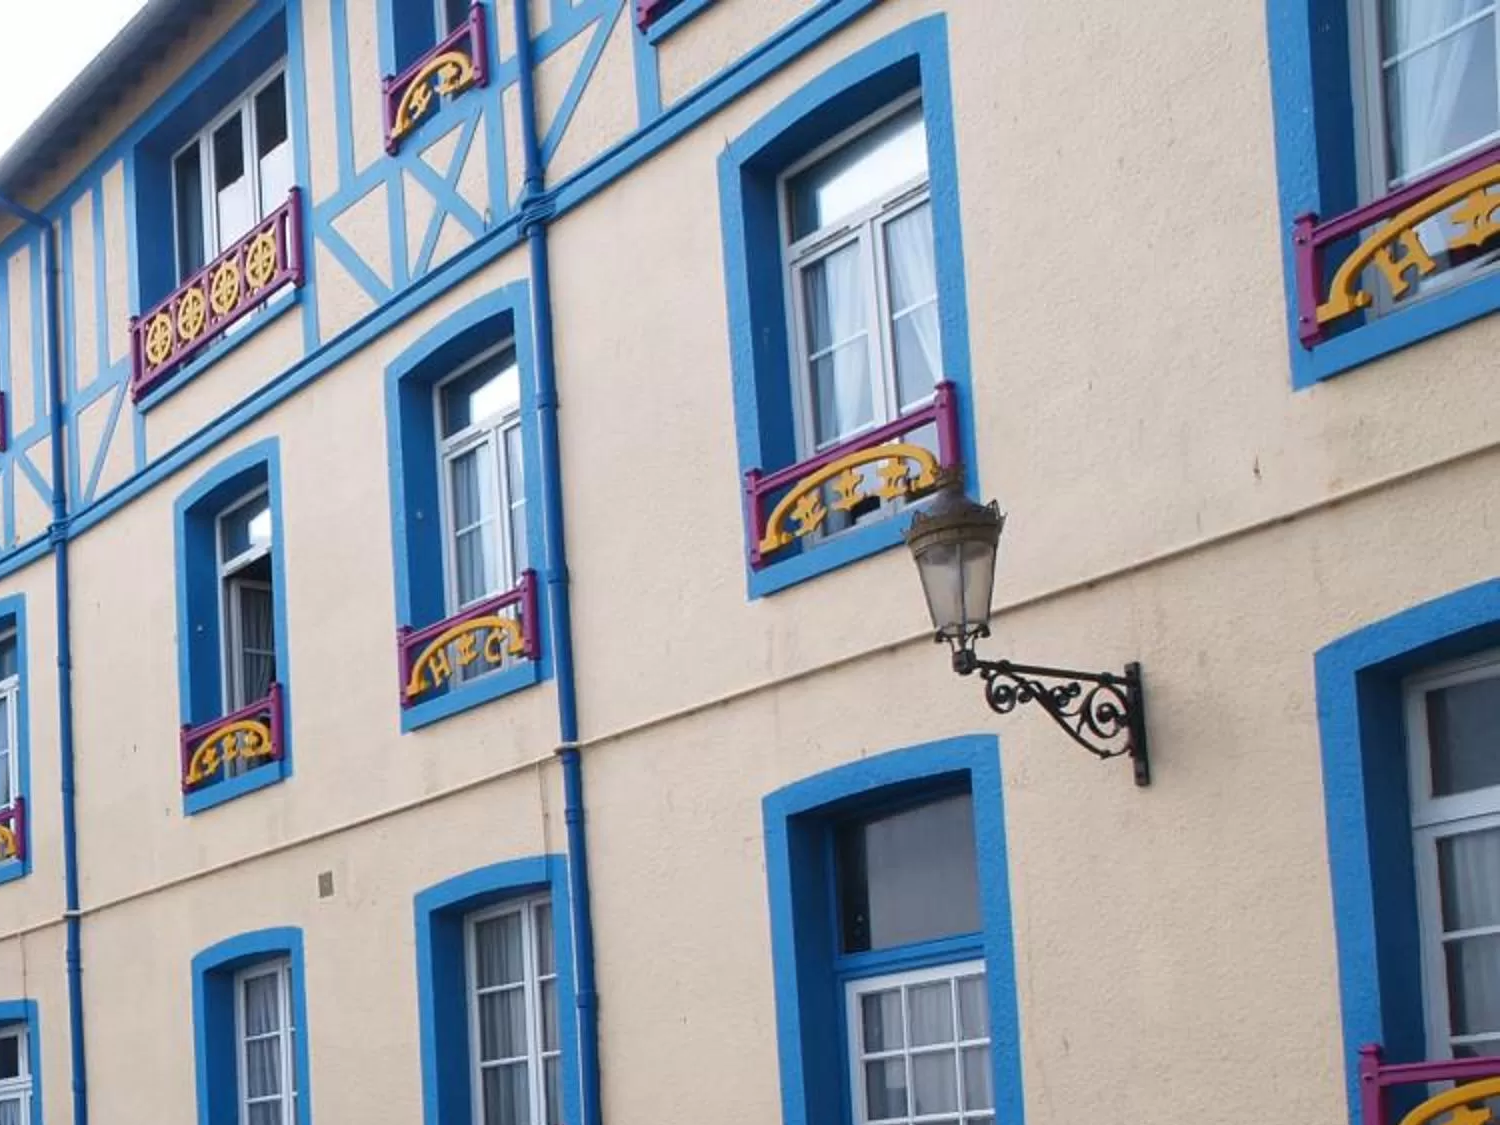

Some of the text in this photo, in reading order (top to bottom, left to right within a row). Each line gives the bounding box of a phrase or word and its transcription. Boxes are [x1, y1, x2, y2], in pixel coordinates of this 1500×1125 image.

[1374, 228, 1436, 301] H
[428, 631, 506, 688] H C
